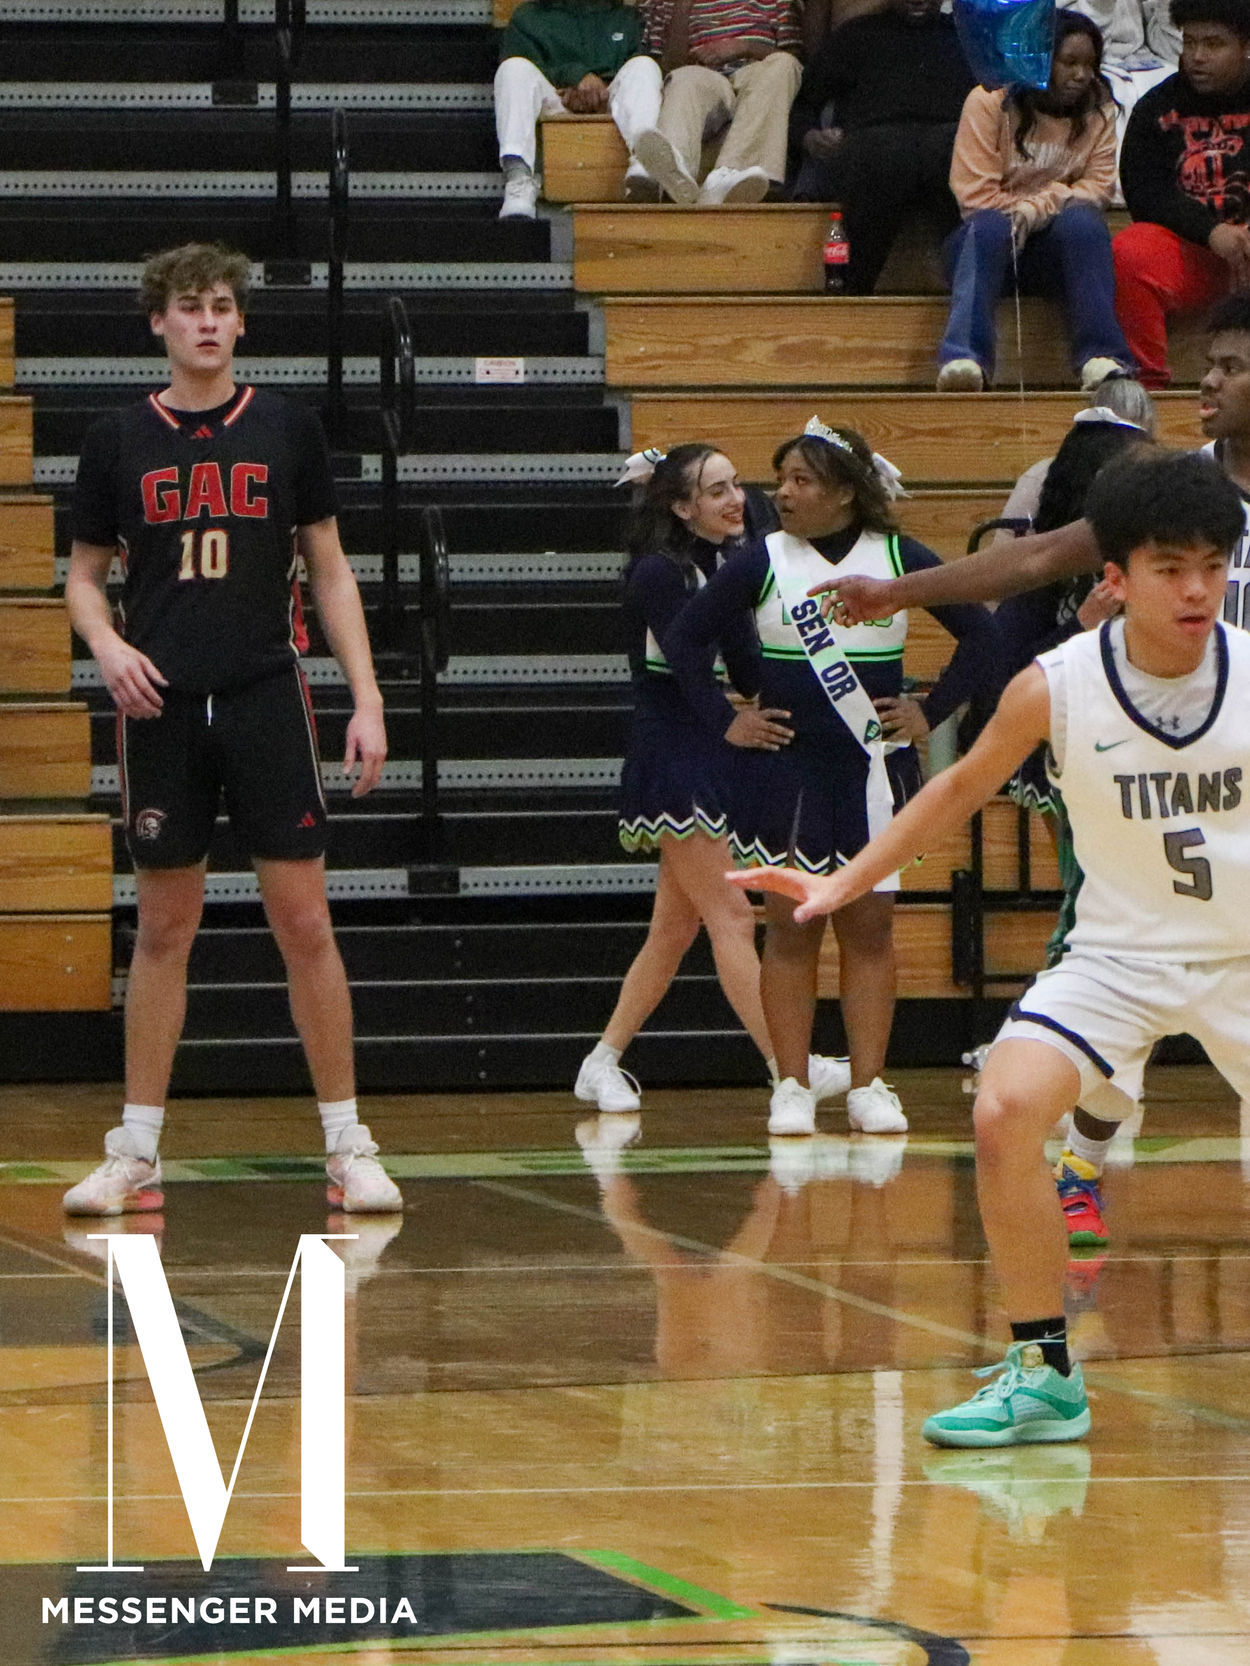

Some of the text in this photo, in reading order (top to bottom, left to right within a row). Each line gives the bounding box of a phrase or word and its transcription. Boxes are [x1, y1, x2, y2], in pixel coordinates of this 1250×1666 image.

[141, 462, 268, 524] GAC
[178, 528, 230, 581] 10
[1113, 767, 1243, 820] TITANS
[1163, 827, 1213, 901] 5
